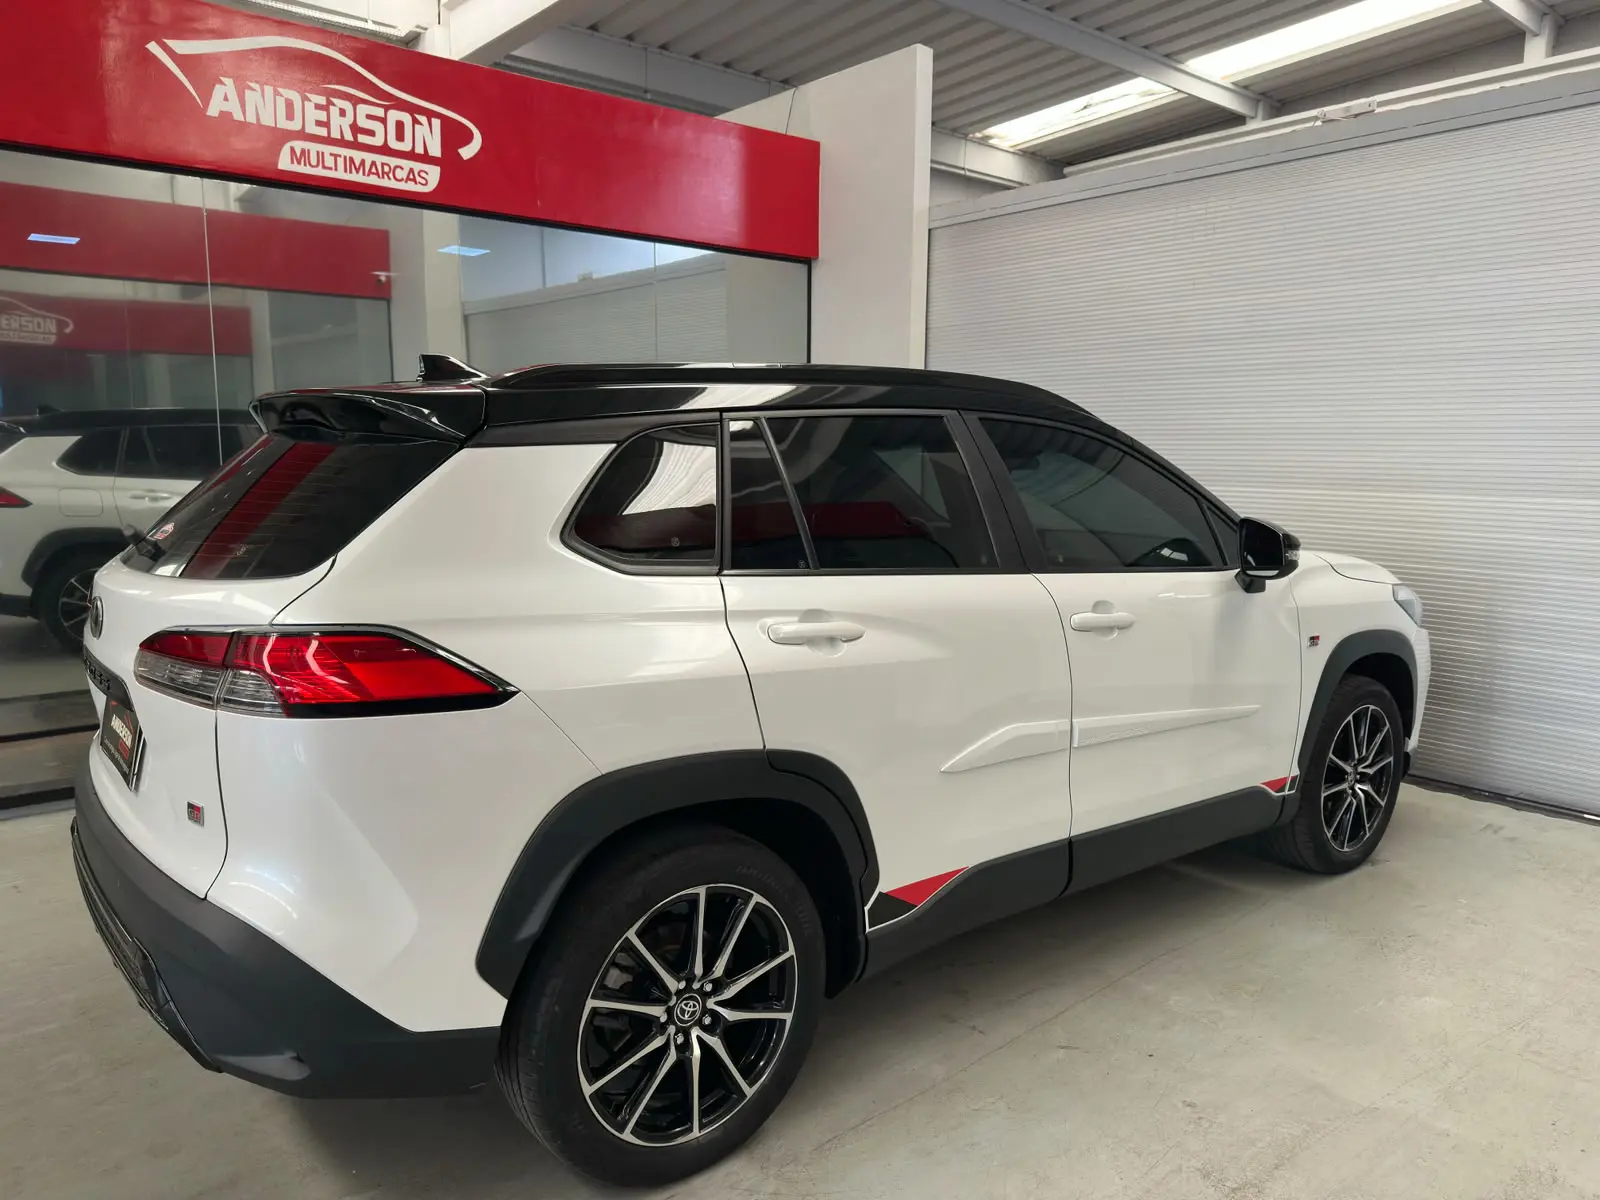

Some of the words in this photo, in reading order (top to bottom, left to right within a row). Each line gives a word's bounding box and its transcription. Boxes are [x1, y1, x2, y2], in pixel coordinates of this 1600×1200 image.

[206, 77, 442, 158] ANDERSON
[289, 145, 429, 187] MULTIMARCAS
[0, 313, 57, 333] ERSON
